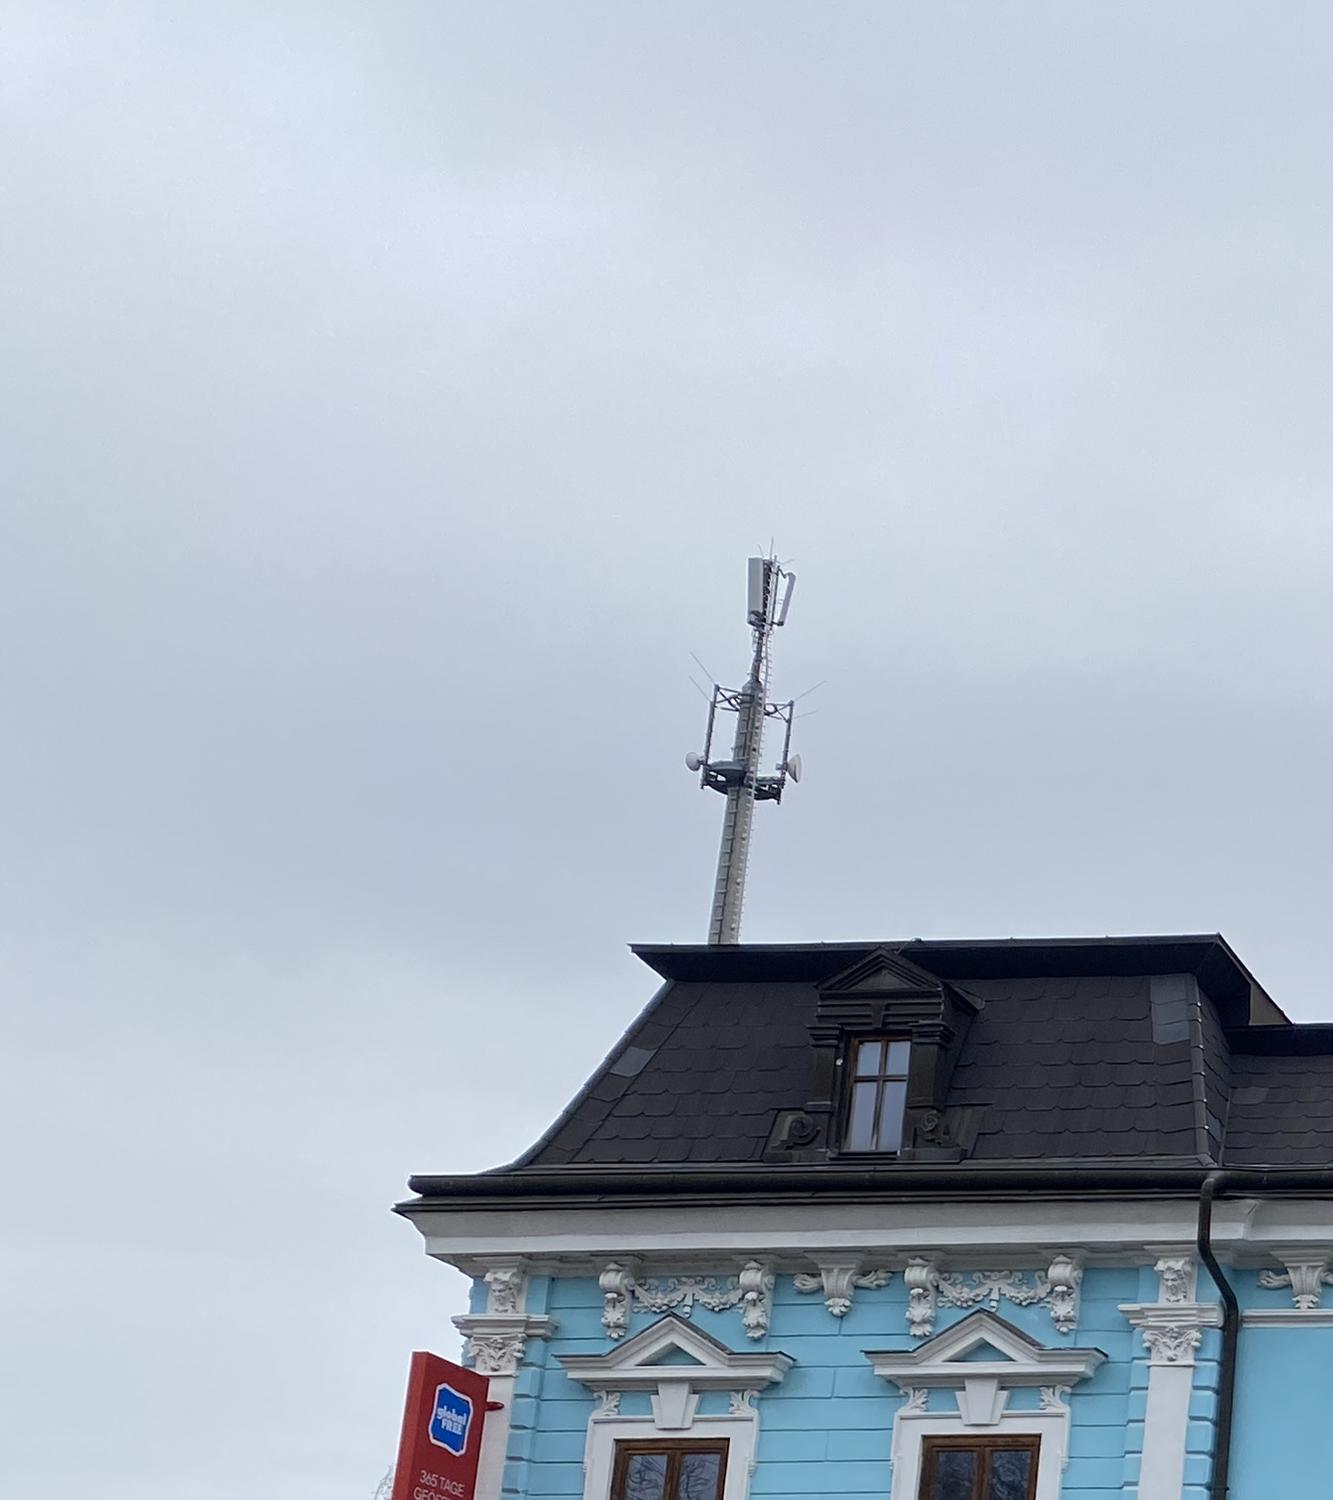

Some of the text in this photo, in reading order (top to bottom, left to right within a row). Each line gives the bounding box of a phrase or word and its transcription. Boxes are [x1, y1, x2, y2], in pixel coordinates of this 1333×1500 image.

[436, 1405, 467, 1425] global
[441, 1418, 464, 1435] FREE
[420, 1470, 465, 1498] 365 TAGE
